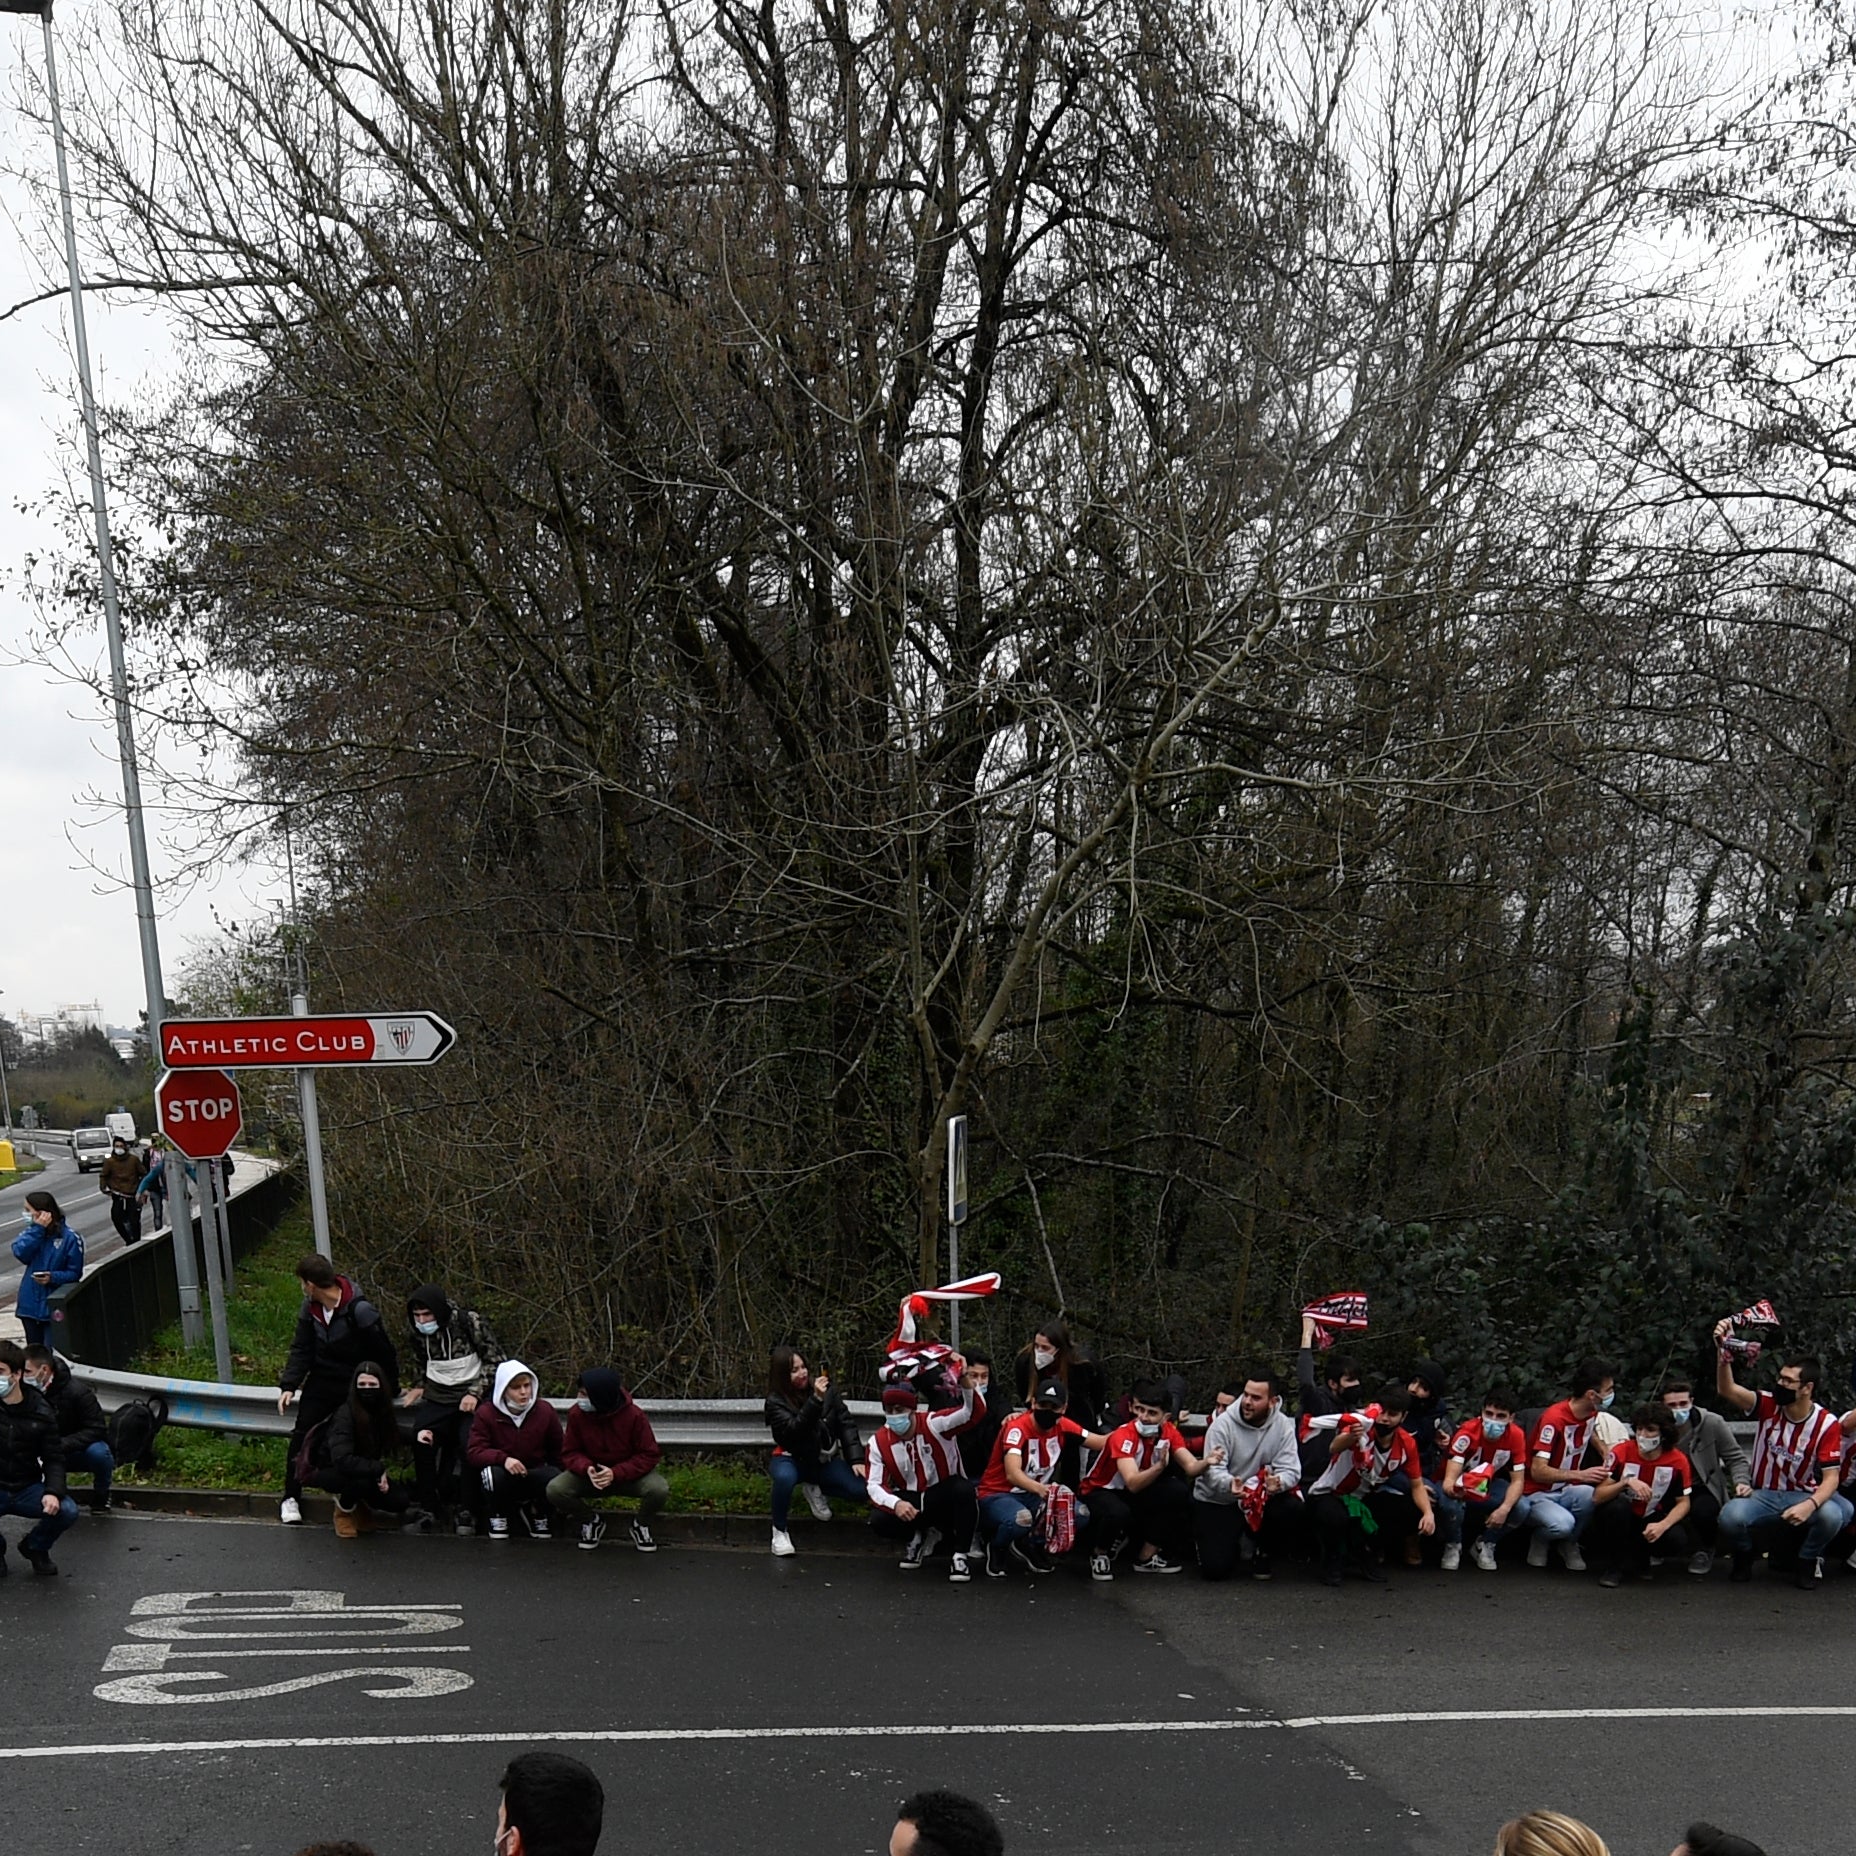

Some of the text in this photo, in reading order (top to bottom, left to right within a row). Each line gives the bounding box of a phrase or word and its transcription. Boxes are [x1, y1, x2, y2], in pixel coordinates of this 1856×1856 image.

[167, 1031, 366, 1054] ATHLETIC CLUB
[168, 1098, 234, 1123] STOP
[93, 1590, 475, 1704] STOP
